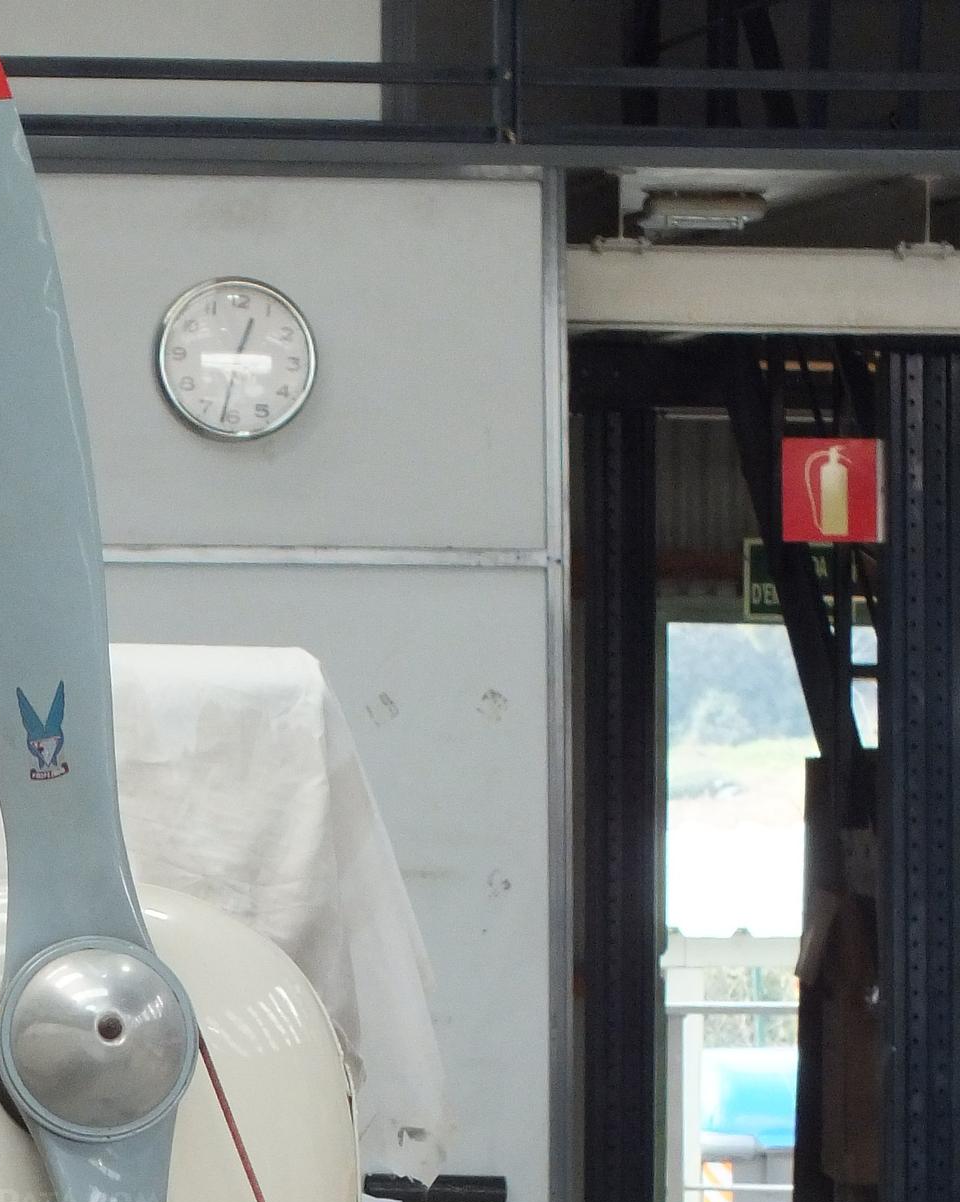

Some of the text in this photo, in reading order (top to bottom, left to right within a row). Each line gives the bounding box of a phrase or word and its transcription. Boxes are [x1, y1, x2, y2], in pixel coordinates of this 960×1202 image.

[279, 326, 295, 342] 2
[171, 346, 187, 361] 9
[286, 356, 301, 372] 3
[180, 376, 196, 392] 8
[276, 384, 289, 399] 4
[199, 398, 213, 414] 7
[254, 403, 270, 418] 5
